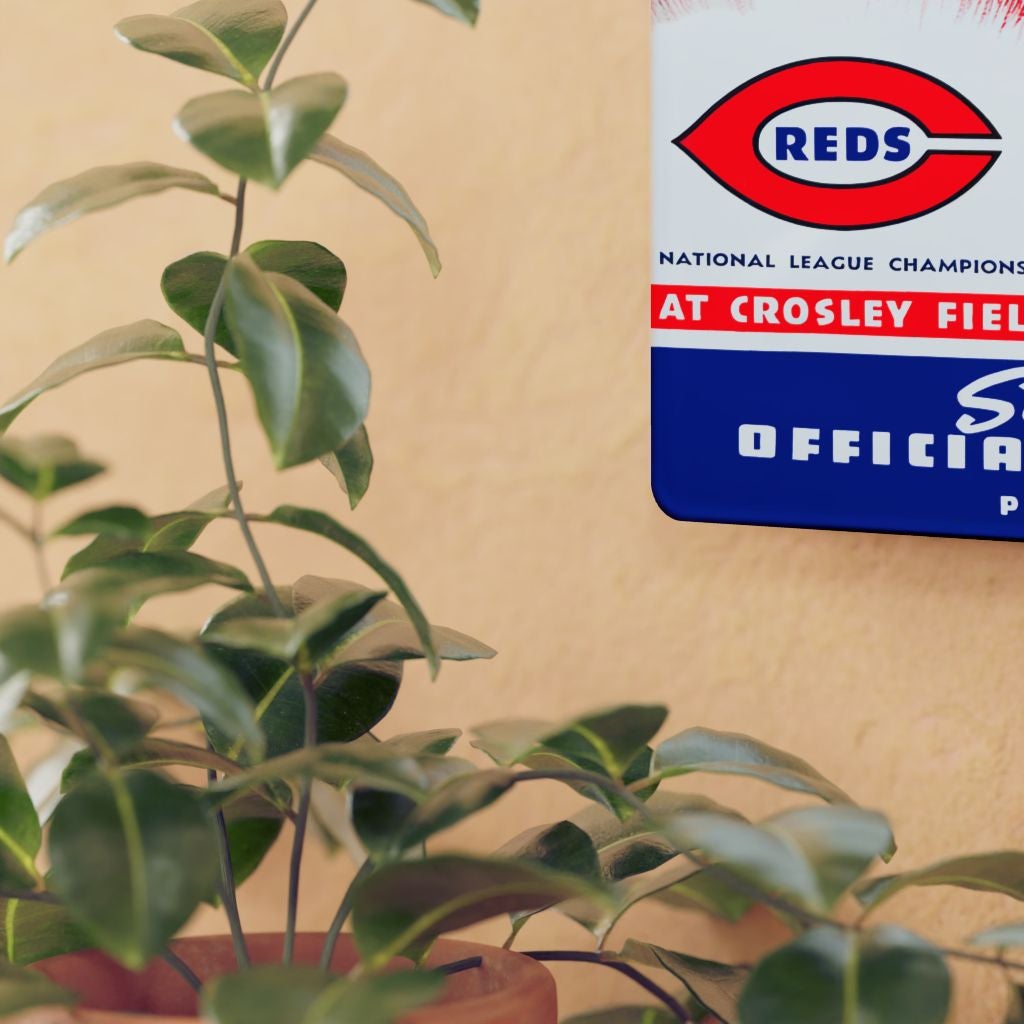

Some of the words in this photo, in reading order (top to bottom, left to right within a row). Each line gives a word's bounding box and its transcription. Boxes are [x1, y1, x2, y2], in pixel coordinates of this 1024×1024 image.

[775, 126, 912, 161] REDS
[659, 252, 775, 268] NATIONAL
[789, 255, 873, 271] LEAGUE
[659, 294, 708, 320] AT
[730, 295, 912, 327] CROSLEY
